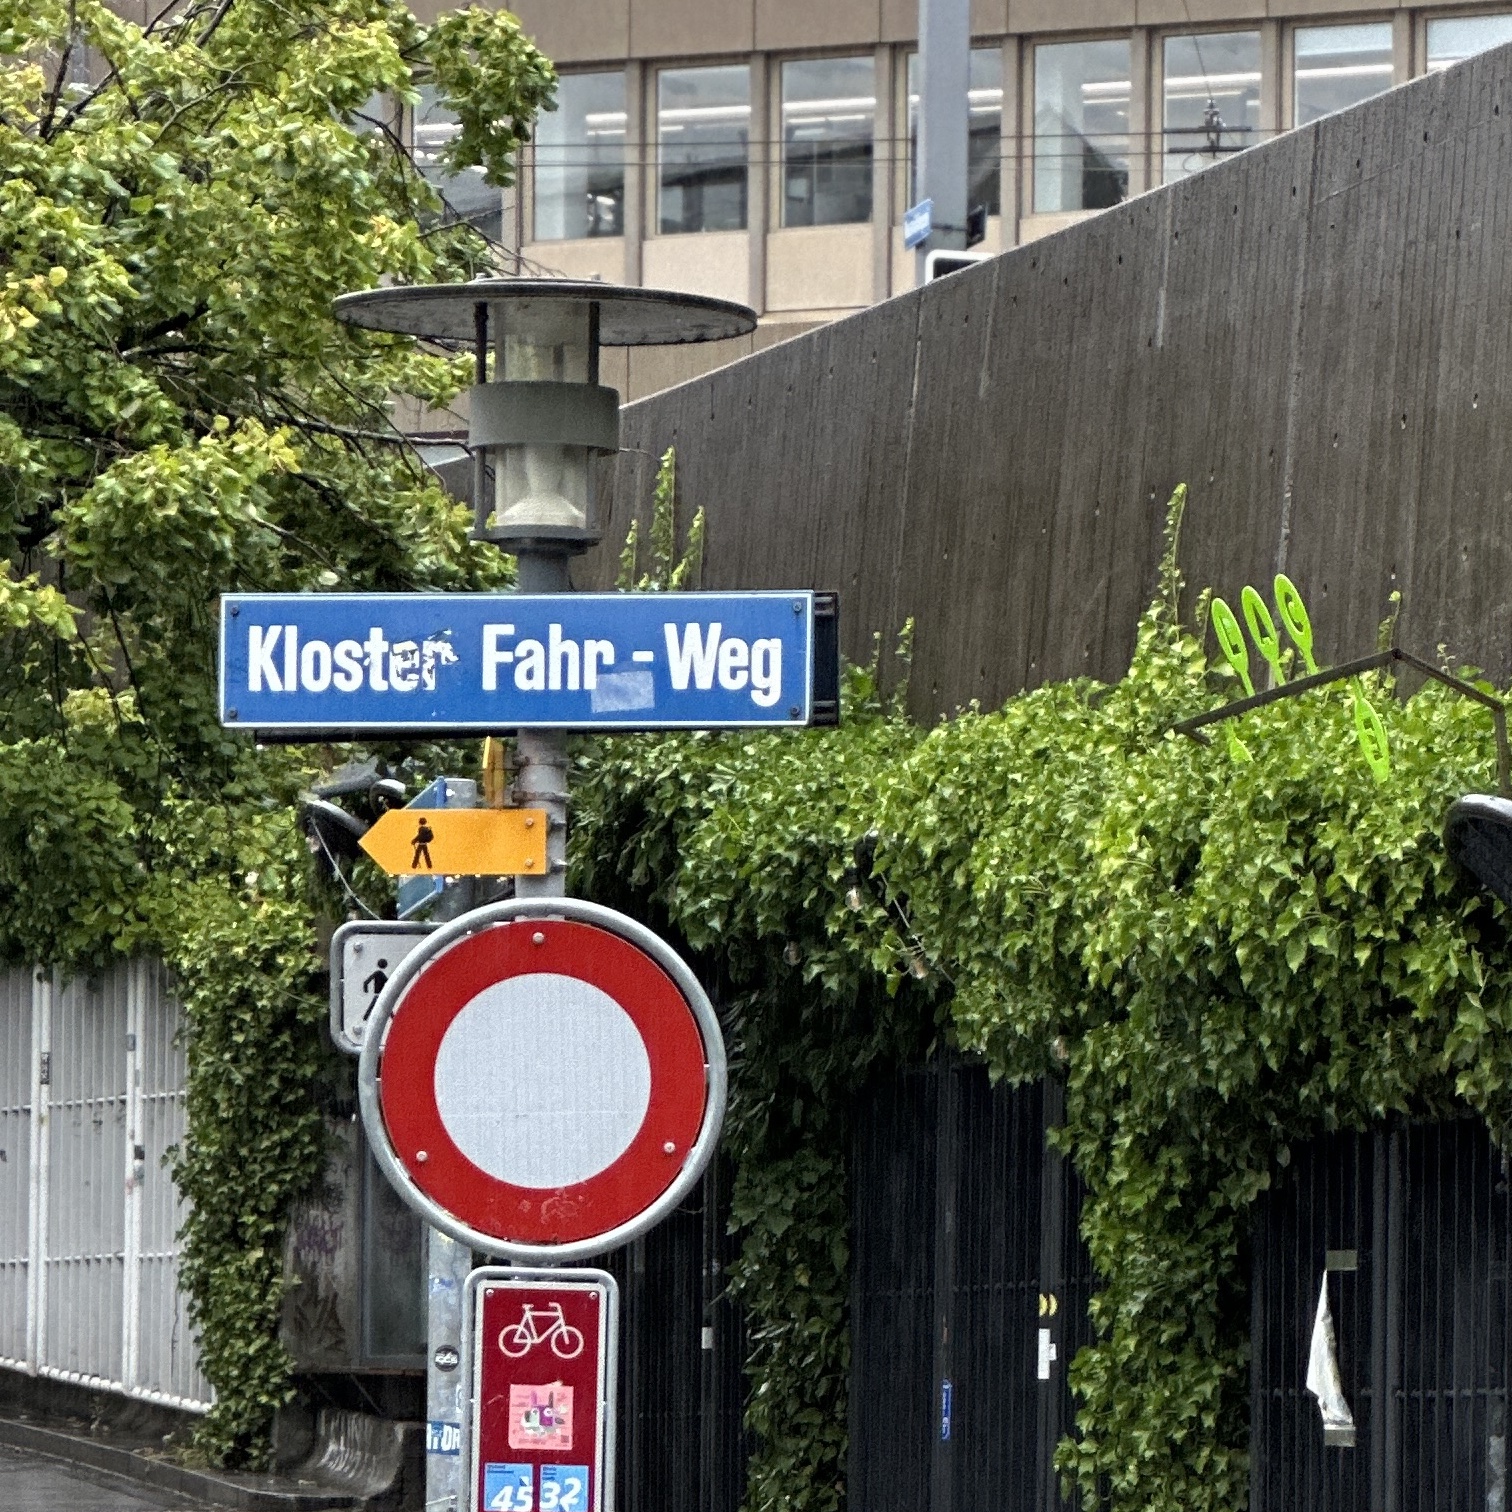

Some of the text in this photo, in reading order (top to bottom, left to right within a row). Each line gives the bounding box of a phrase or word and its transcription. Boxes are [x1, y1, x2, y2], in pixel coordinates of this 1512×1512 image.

[247, 624, 459, 693] Kloster
[490, 1476, 582, 1512] 45 32
